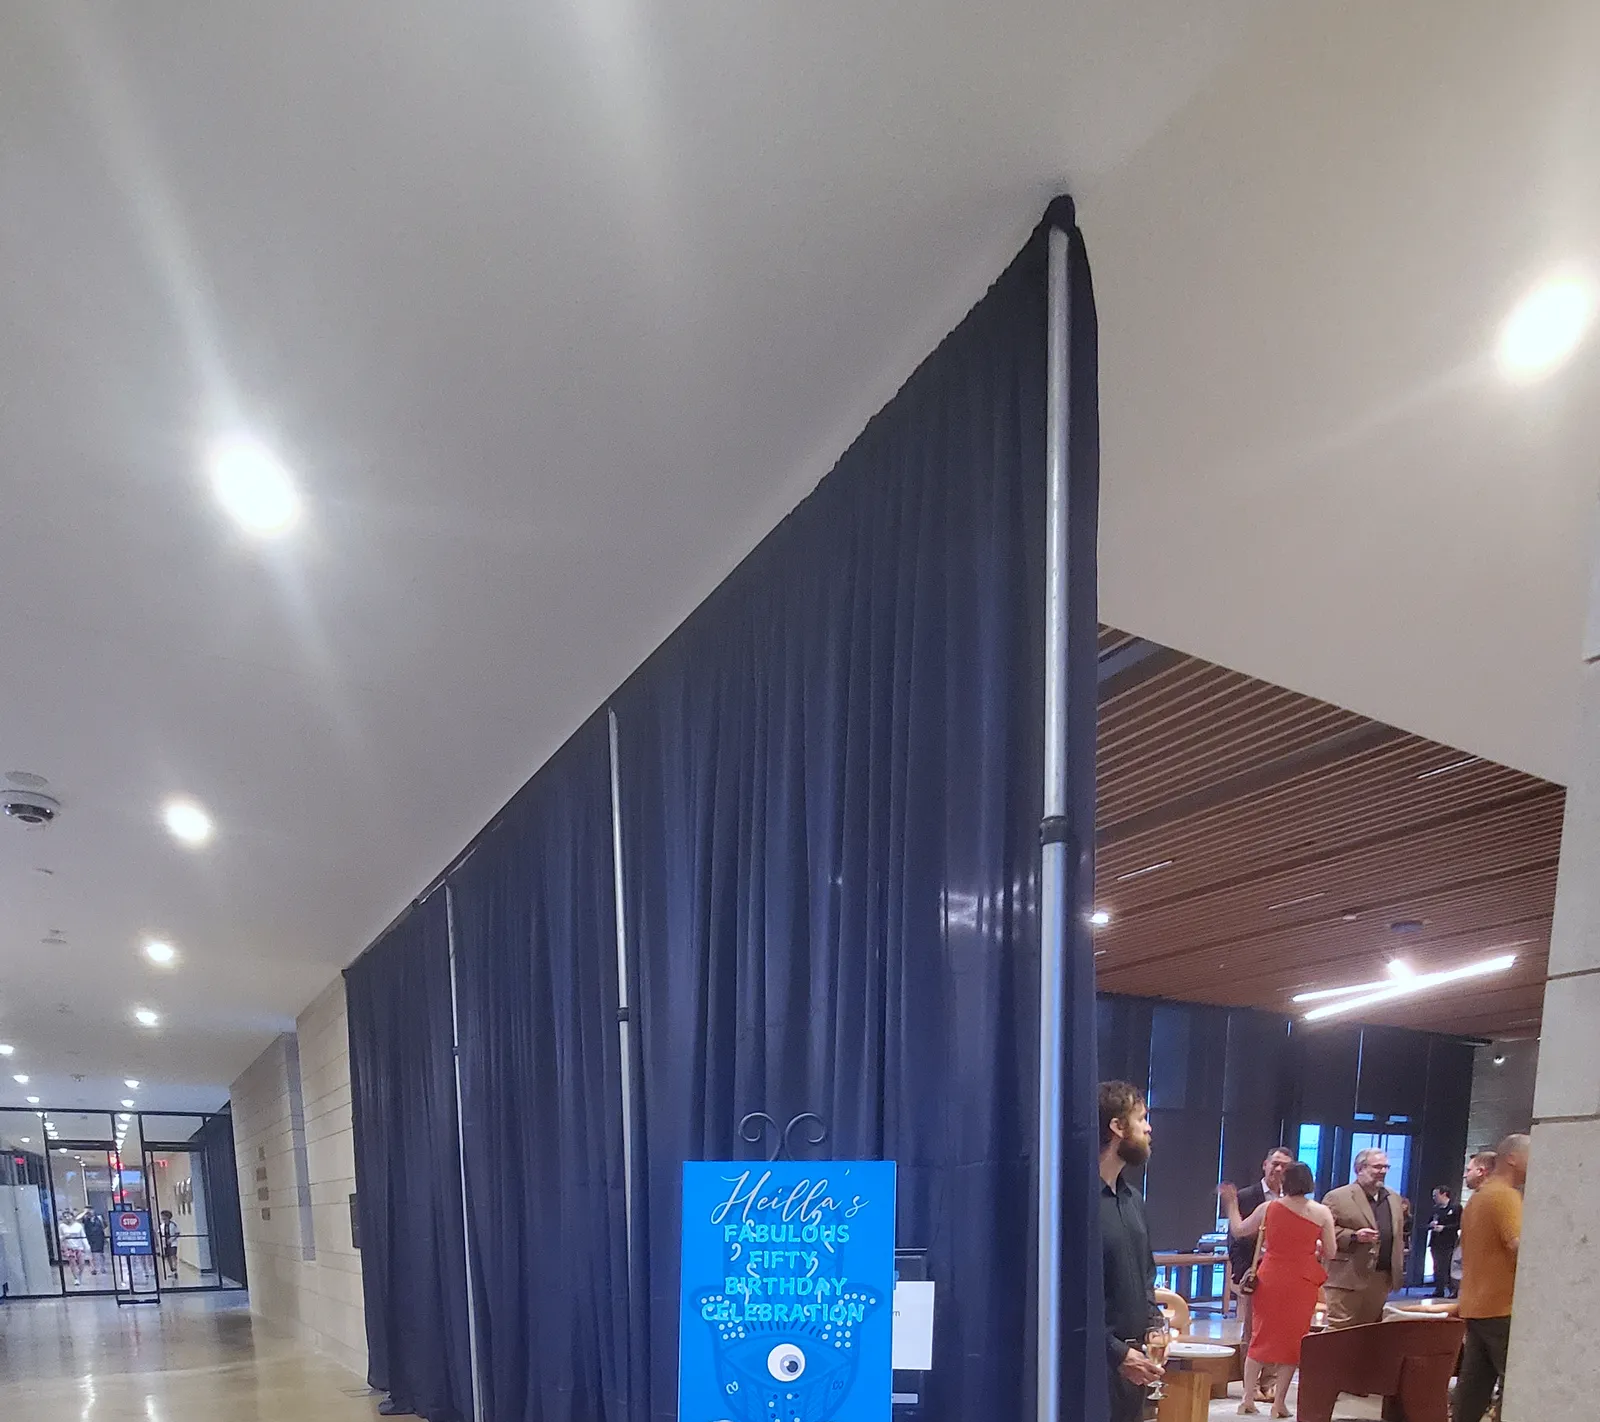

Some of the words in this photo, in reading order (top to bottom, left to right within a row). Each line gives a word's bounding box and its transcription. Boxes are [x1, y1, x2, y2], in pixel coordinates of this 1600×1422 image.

[710, 1168, 869, 1224] Heilla's
[724, 1224, 850, 1243] FABULOUS
[749, 1250, 817, 1269] FIFTY
[724, 1277, 848, 1296] BIRTHDAY
[701, 1303, 865, 1323] CELEBRATION
